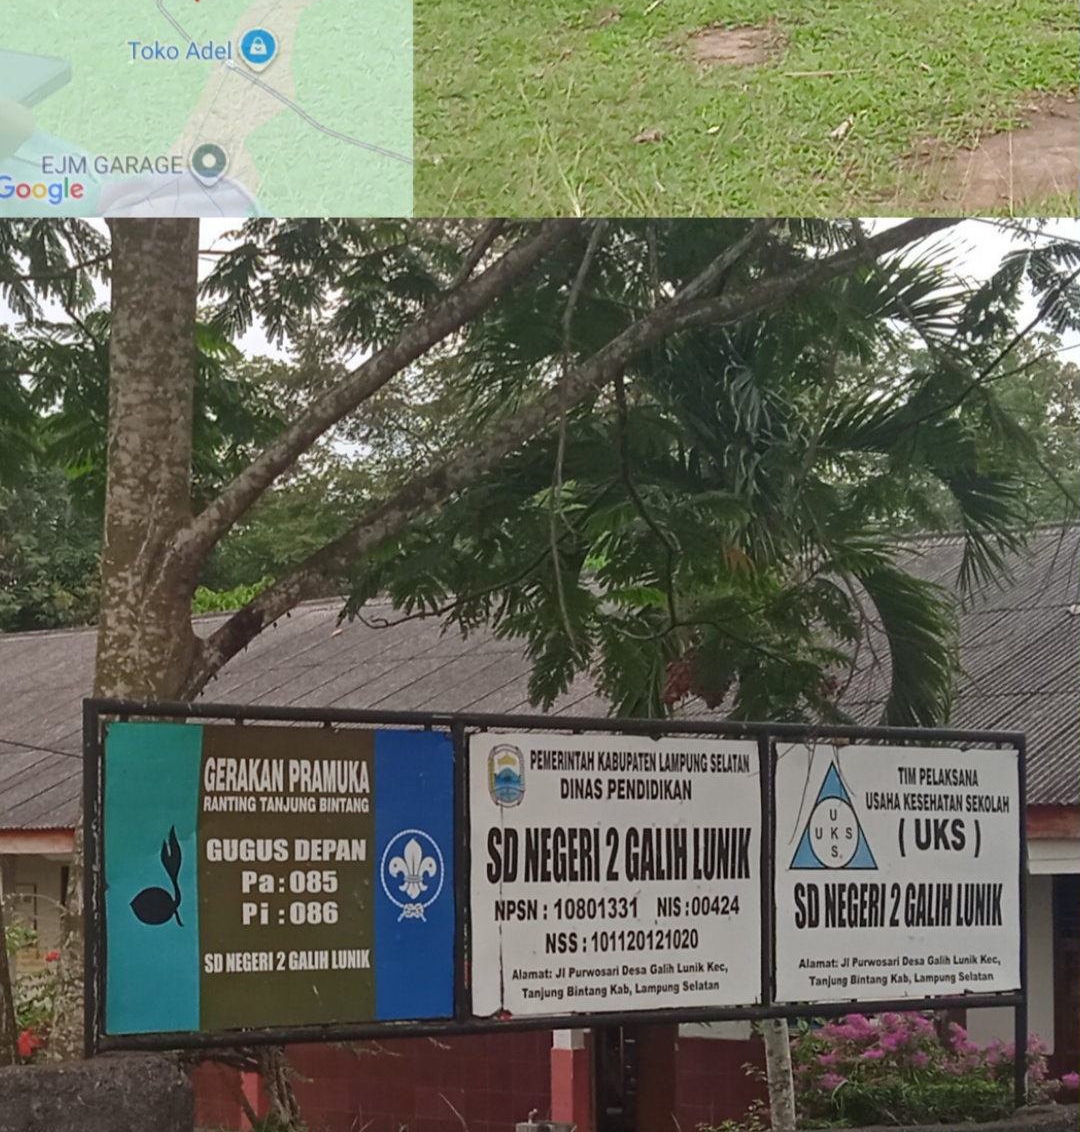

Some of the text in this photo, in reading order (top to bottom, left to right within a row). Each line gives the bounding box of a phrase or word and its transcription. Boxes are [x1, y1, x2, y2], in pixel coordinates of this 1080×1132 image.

[530, 750, 750, 774] PEMERINTAH KABUPATEN LAMPUNG SELATAN
[204, 758, 370, 793] GERAKAN PRAMUKA
[898, 767, 978, 787] TIM PELAKSANA
[560, 778, 692, 800] DINAS PENDIDIKAN
[203, 796, 369, 813] RANTING TANJUNG BINTANG
[866, 792, 1009, 813] USAHA KESEHATAN SEKOLAH
[206, 839, 366, 862] GUGUS DEPAN
[487, 827, 751, 884] SD NEGERI 2 GALIH LUNIK
[494, 900, 538, 921] NPSN
[554, 897, 638, 919] 10801331
[657, 897, 681, 917] NIS
[794, 883, 1003, 929] SD NEGERI 2 GALIH LUNIK
[546, 932, 578, 953] NSS
[591, 929, 698, 952] 101120121020
[204, 949, 370, 973] SD NEGERI 2 GALIH LUNIK
[512, 969, 552, 980] Alamat:
[568, 966, 619, 978] Purwosari
[622, 966, 646, 976] Desa
[650, 964, 674, 974] Galih
[677, 963, 704, 974] Lunik
[707, 962, 728, 974] Kec,
[799, 959, 838, 969] Alamat:
[852, 956, 899, 967] Purwosari
[902, 957, 925, 966] Desa
[927, 955, 950, 965] Galih
[953, 955, 978, 965] Lunik
[981, 954, 1001, 965] Kec,
[522, 980, 720, 1000] Tanjung Bintang Kab, Lampung Selatan
[809, 972, 994, 988] Tanjung Bintang Kab, Lampung Selatan
